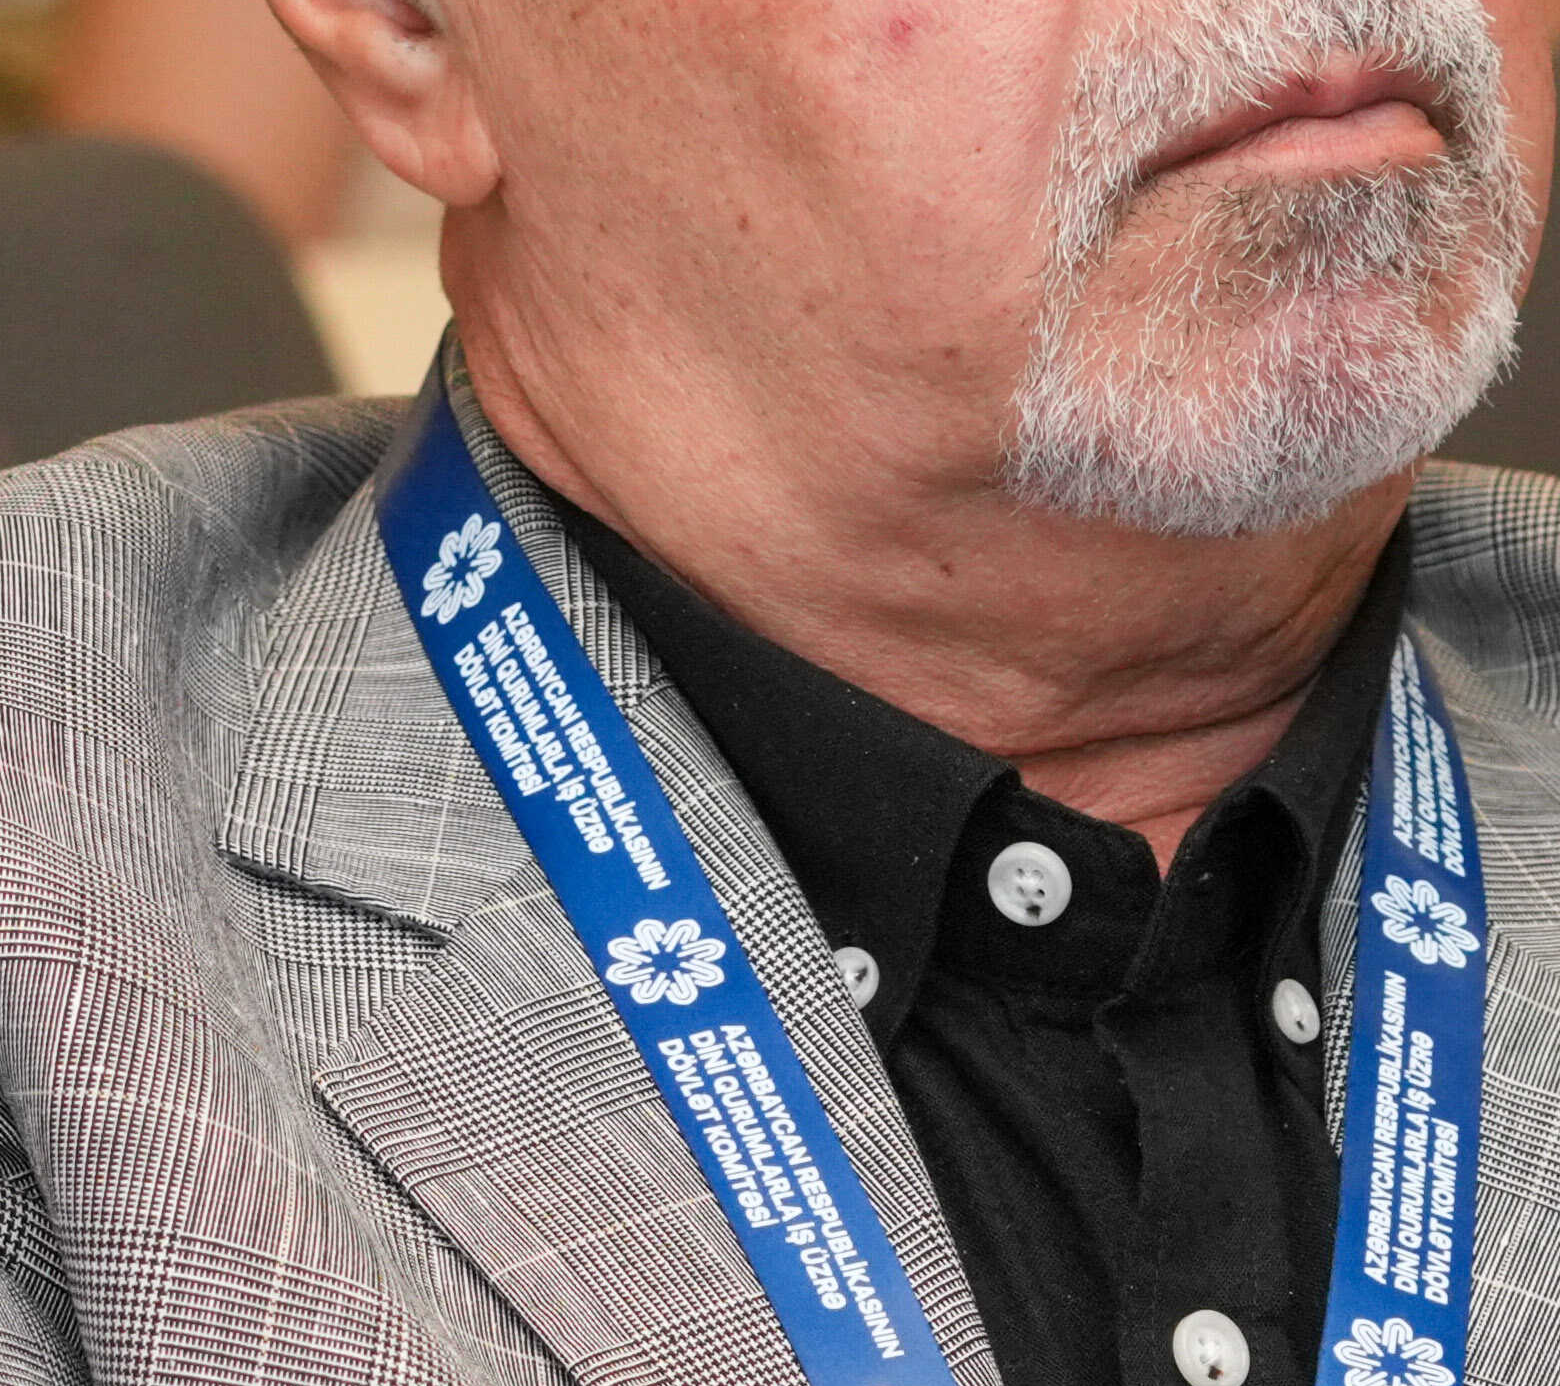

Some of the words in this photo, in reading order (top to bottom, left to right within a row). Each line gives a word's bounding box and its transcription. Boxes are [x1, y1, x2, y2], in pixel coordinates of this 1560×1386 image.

[478, 621, 514, 666] DİNİ
[454, 643, 503, 716] DÖVLƏT
[486, 710, 551, 796] KOMİTƏSİ
[497, 659, 573, 783] QURUMLARLA
[501, 602, 582, 727] AZƏRBAYCAN
[565, 720, 671, 890] RESPUBLİKASININ
[556, 775, 585, 801] İŞ
[569, 798, 614, 853] ÜZRƏ
[689, 1030, 732, 1075] DİNİ
[1374, 971, 1406, 1145] RESPUBLİKASININ
[1402, 1088, 1435, 1111] İŞ
[1404, 1031, 1433, 1088] ÜZRƏ
[658, 1038, 722, 1121] DÖVLƏT
[704, 1125, 780, 1228] KOMİTƏSİ
[714, 1076, 803, 1222] QURUMLARLA
[1428, 1118, 1458, 1220] KOMİTƏSİ
[720, 1025, 812, 1165] AZƏRBAYCAN
[794, 1166, 904, 1358] RESPUBLİKASININ
[1364, 1143, 1395, 1284] AZƏRBAYCAN
[1398, 1113, 1429, 1248] QURUMLARLA
[785, 1222, 816, 1245] İŞ
[800, 1247, 846, 1309] ÜZRƏ
[1391, 1247, 1420, 1294] DİNİ
[1423, 1217, 1452, 1304] DÖVLƏT
